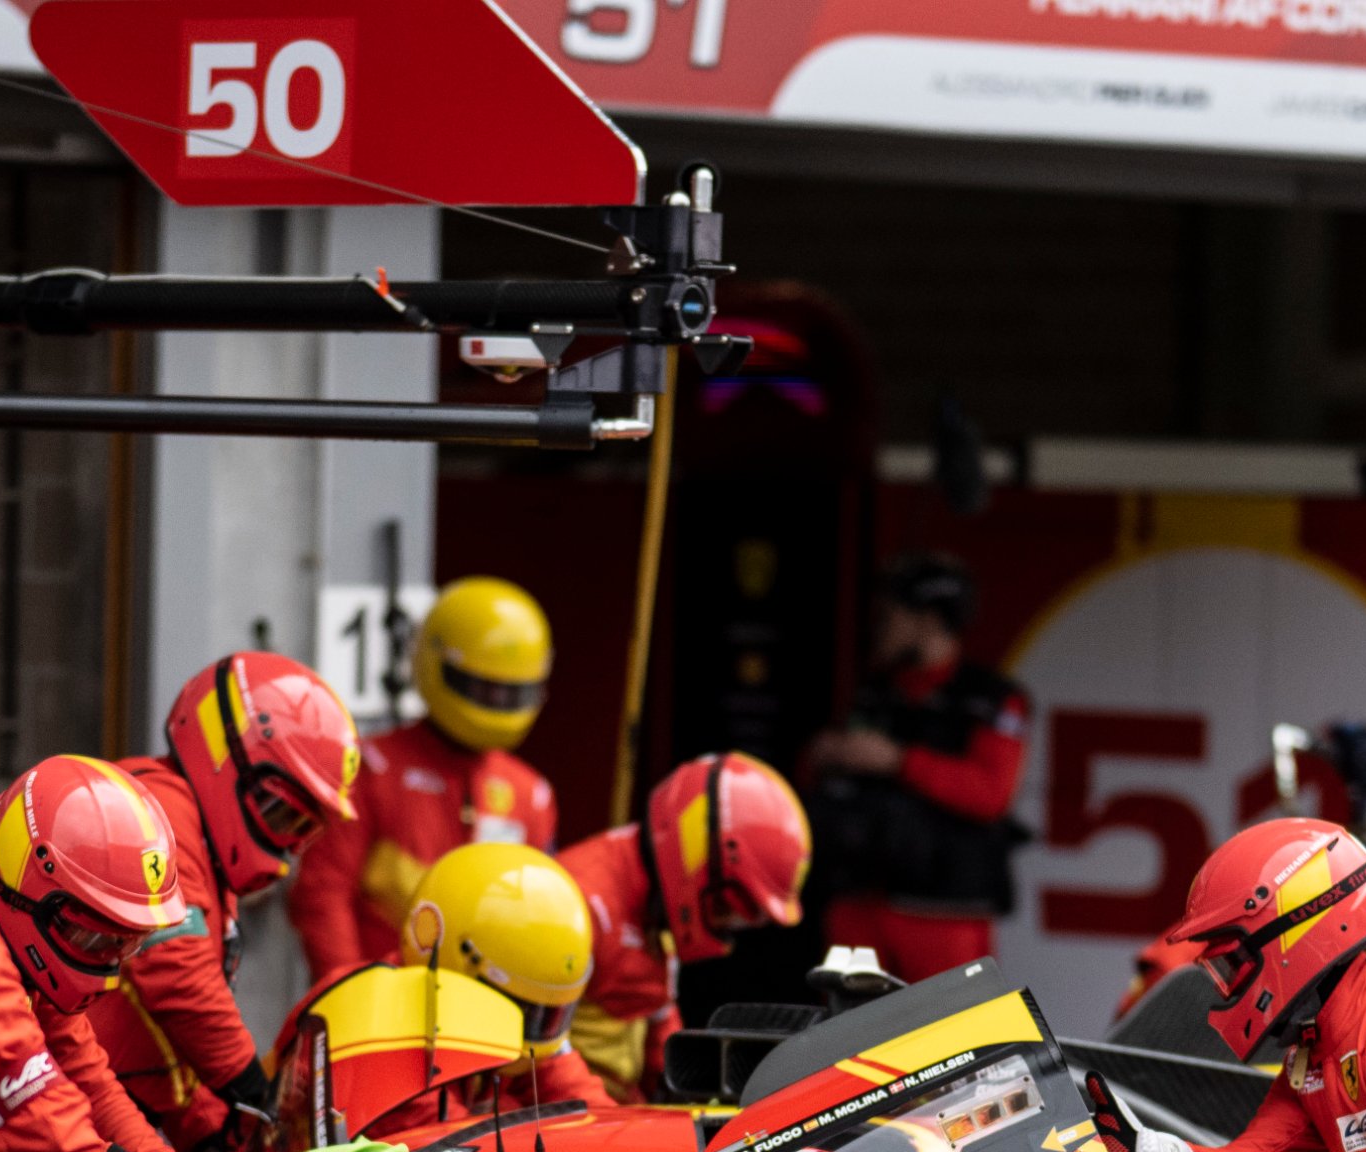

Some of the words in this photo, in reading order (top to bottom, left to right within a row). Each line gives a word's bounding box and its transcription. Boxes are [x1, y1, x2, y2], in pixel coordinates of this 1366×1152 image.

[185, 38, 346, 159] 50
[919, 1051, 975, 1082] NIELSEN
[835, 1089, 889, 1119] MOLINA
